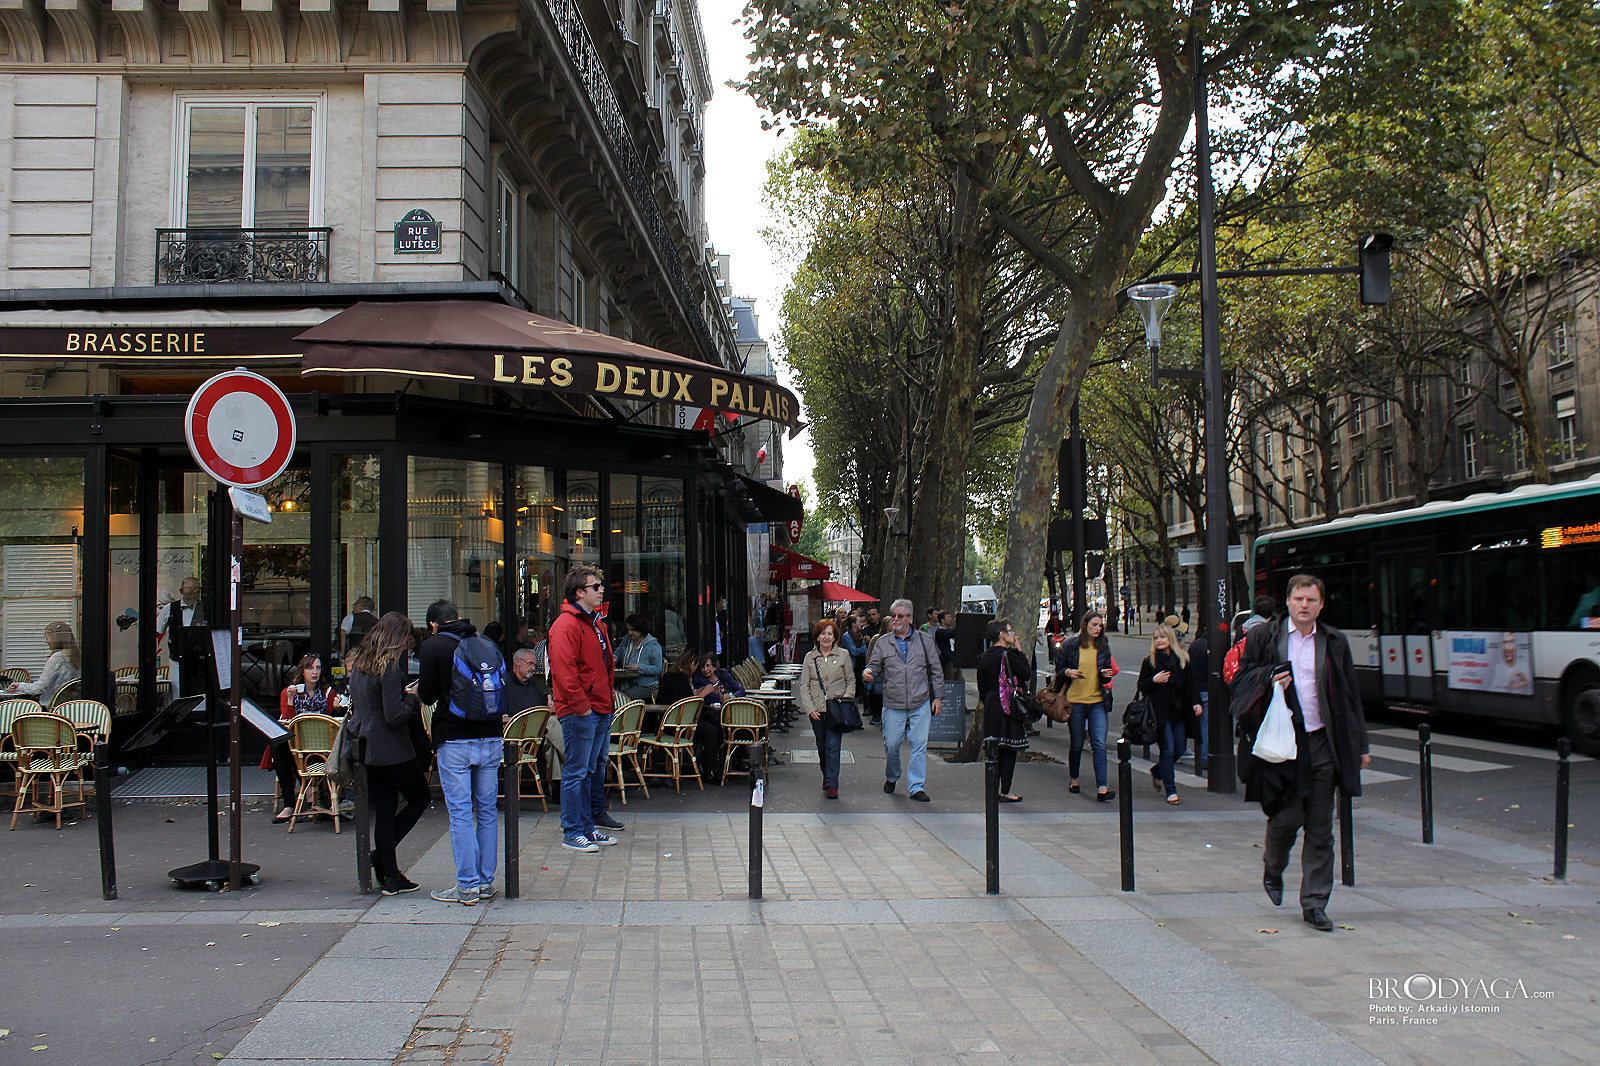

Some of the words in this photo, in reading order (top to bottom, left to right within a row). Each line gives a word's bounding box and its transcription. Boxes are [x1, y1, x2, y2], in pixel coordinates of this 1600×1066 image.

[399, 239, 437, 249] LUTÈCE
[66, 333, 205, 353] BRASSERIE
[493, 354, 574, 388] LES
[595, 361, 693, 403] DEUX
[710, 377, 789, 422] PALAIS
[790, 489, 799, 538] TAC
